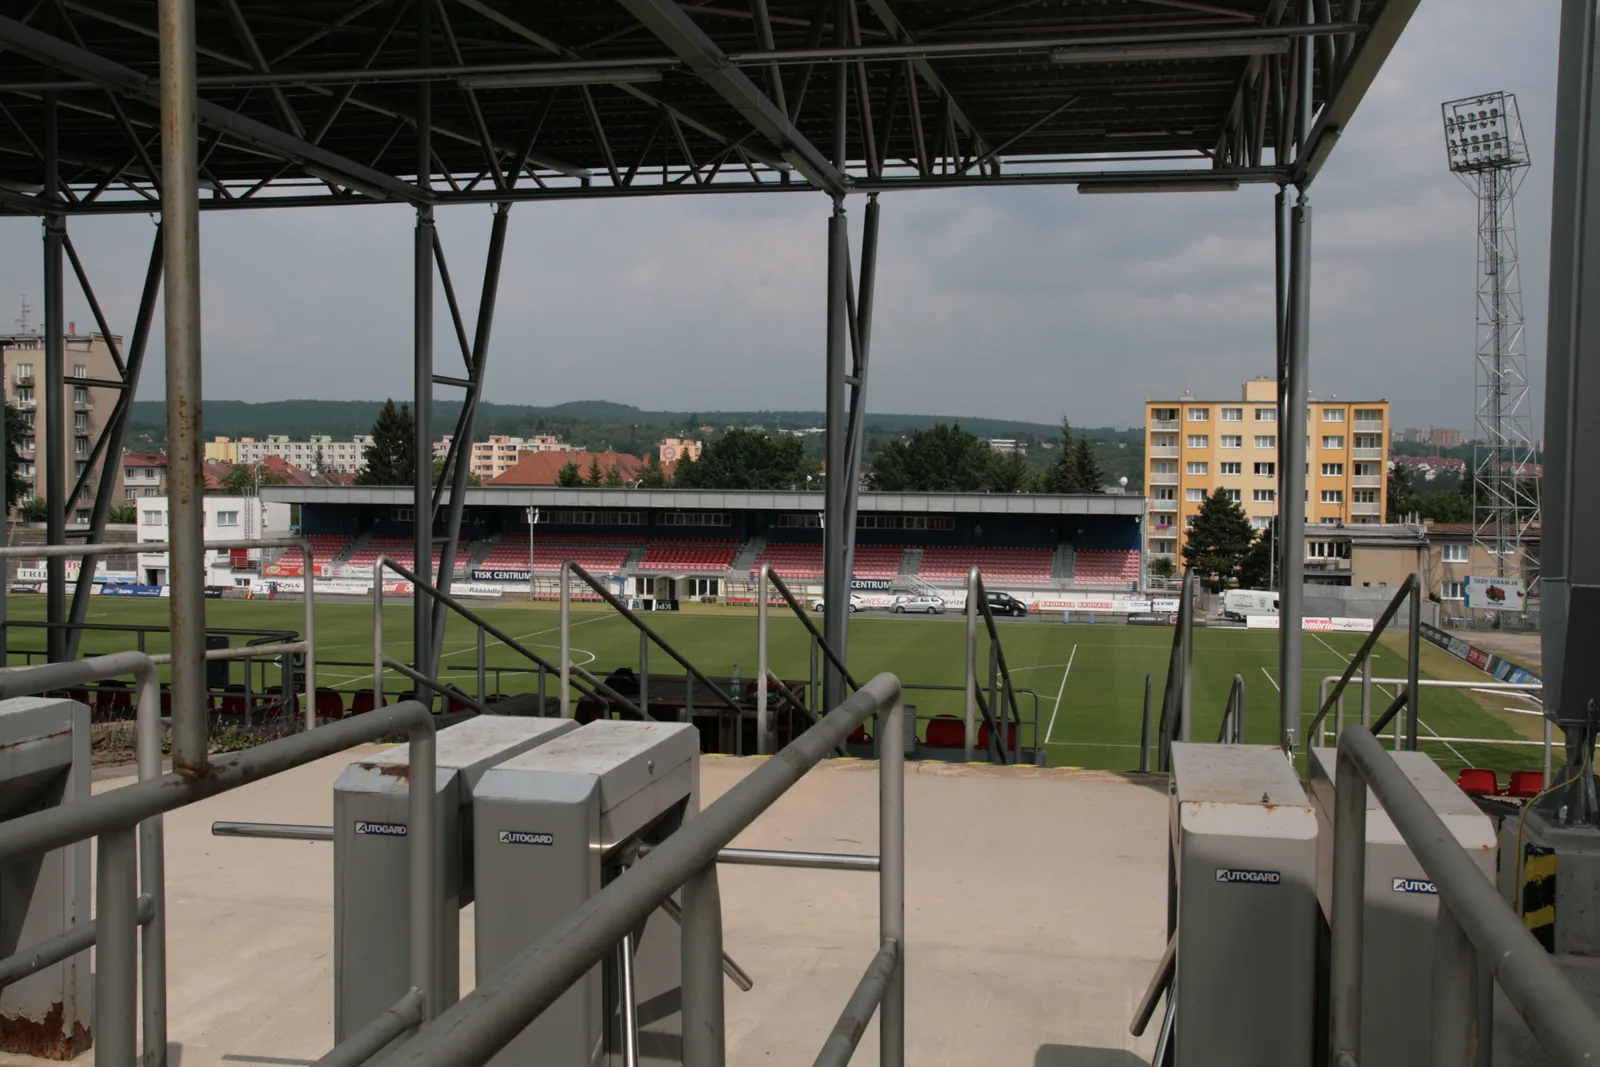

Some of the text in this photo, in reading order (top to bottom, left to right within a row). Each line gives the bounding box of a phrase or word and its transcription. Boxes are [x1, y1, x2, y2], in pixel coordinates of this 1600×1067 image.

[474, 571, 531, 580] TISK CENTRUM
[851, 580, 892, 589] CENTRUM
[356, 823, 407, 834] AUTOGARD
[500, 832, 553, 844] AUTOGARD
[1217, 870, 1280, 882] AUTOGARD
[1394, 879, 1438, 892] AUTOG
